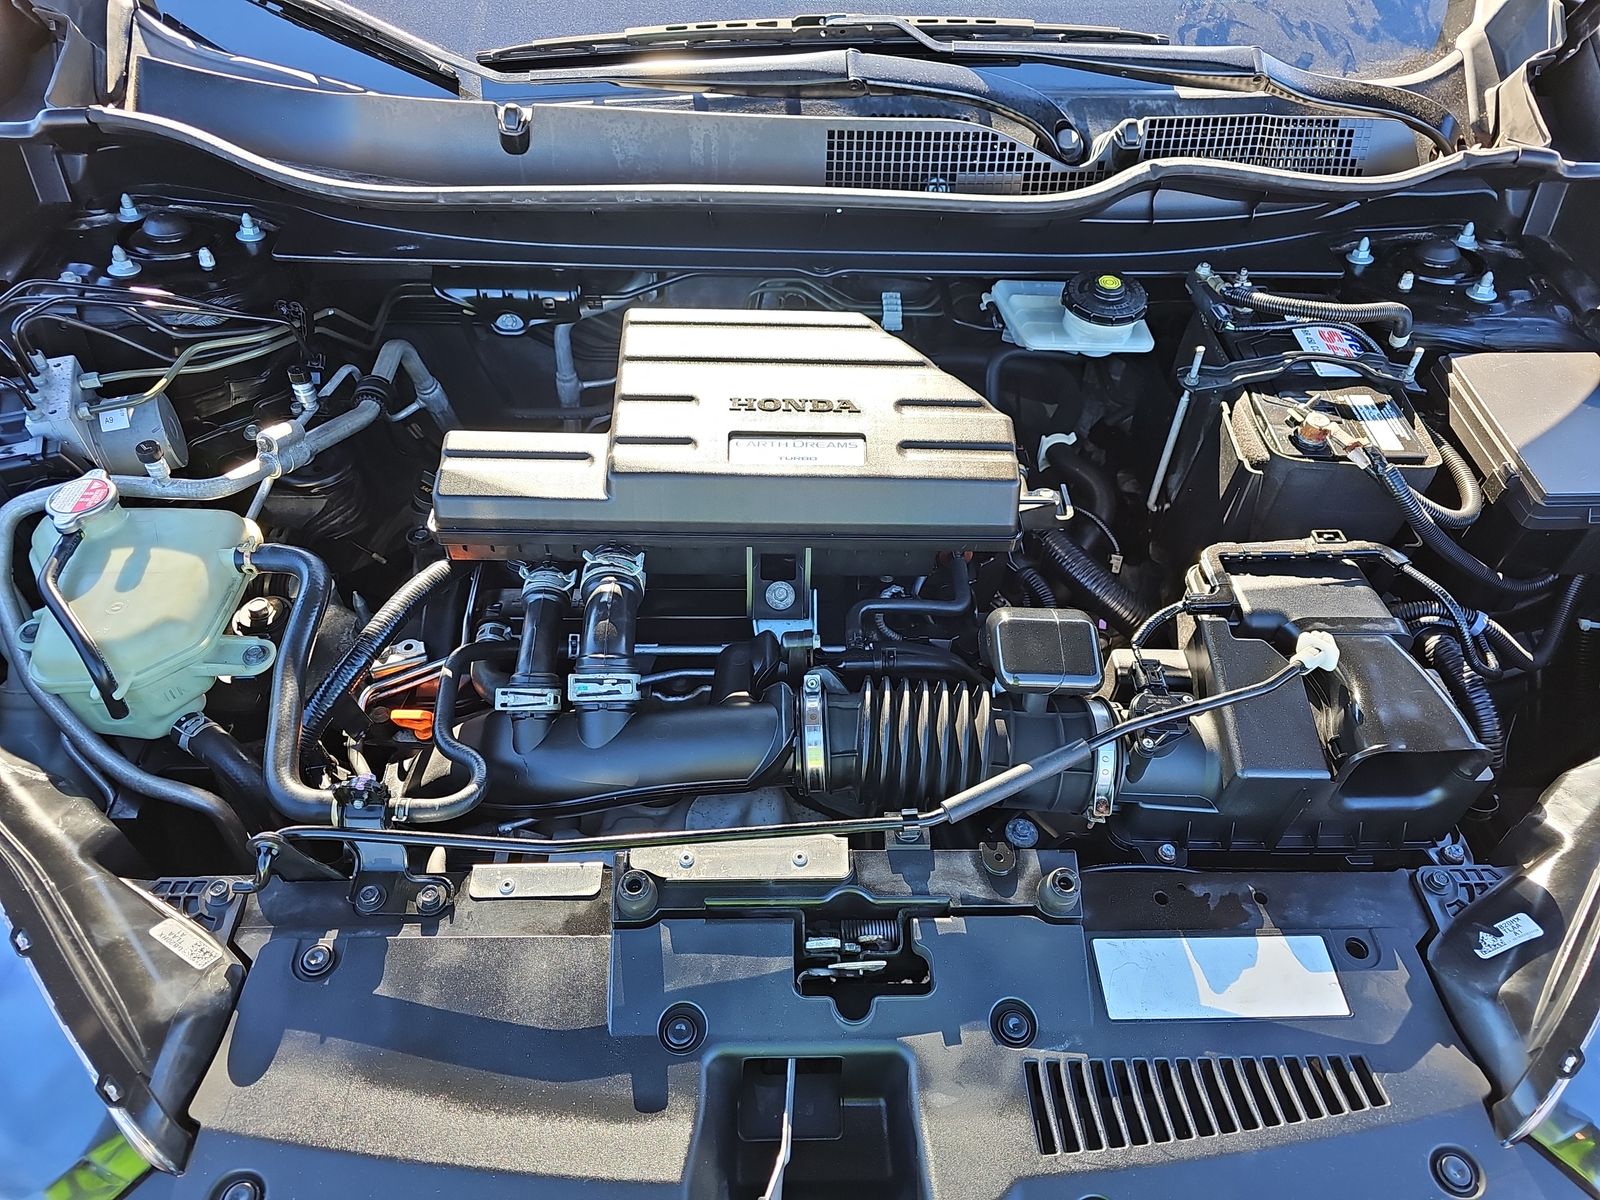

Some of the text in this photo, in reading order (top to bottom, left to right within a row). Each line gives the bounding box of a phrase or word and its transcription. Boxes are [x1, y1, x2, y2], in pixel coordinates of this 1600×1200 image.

[729, 398, 861, 413] HONDA
[736, 440, 858, 449] EARTH DREAMS
